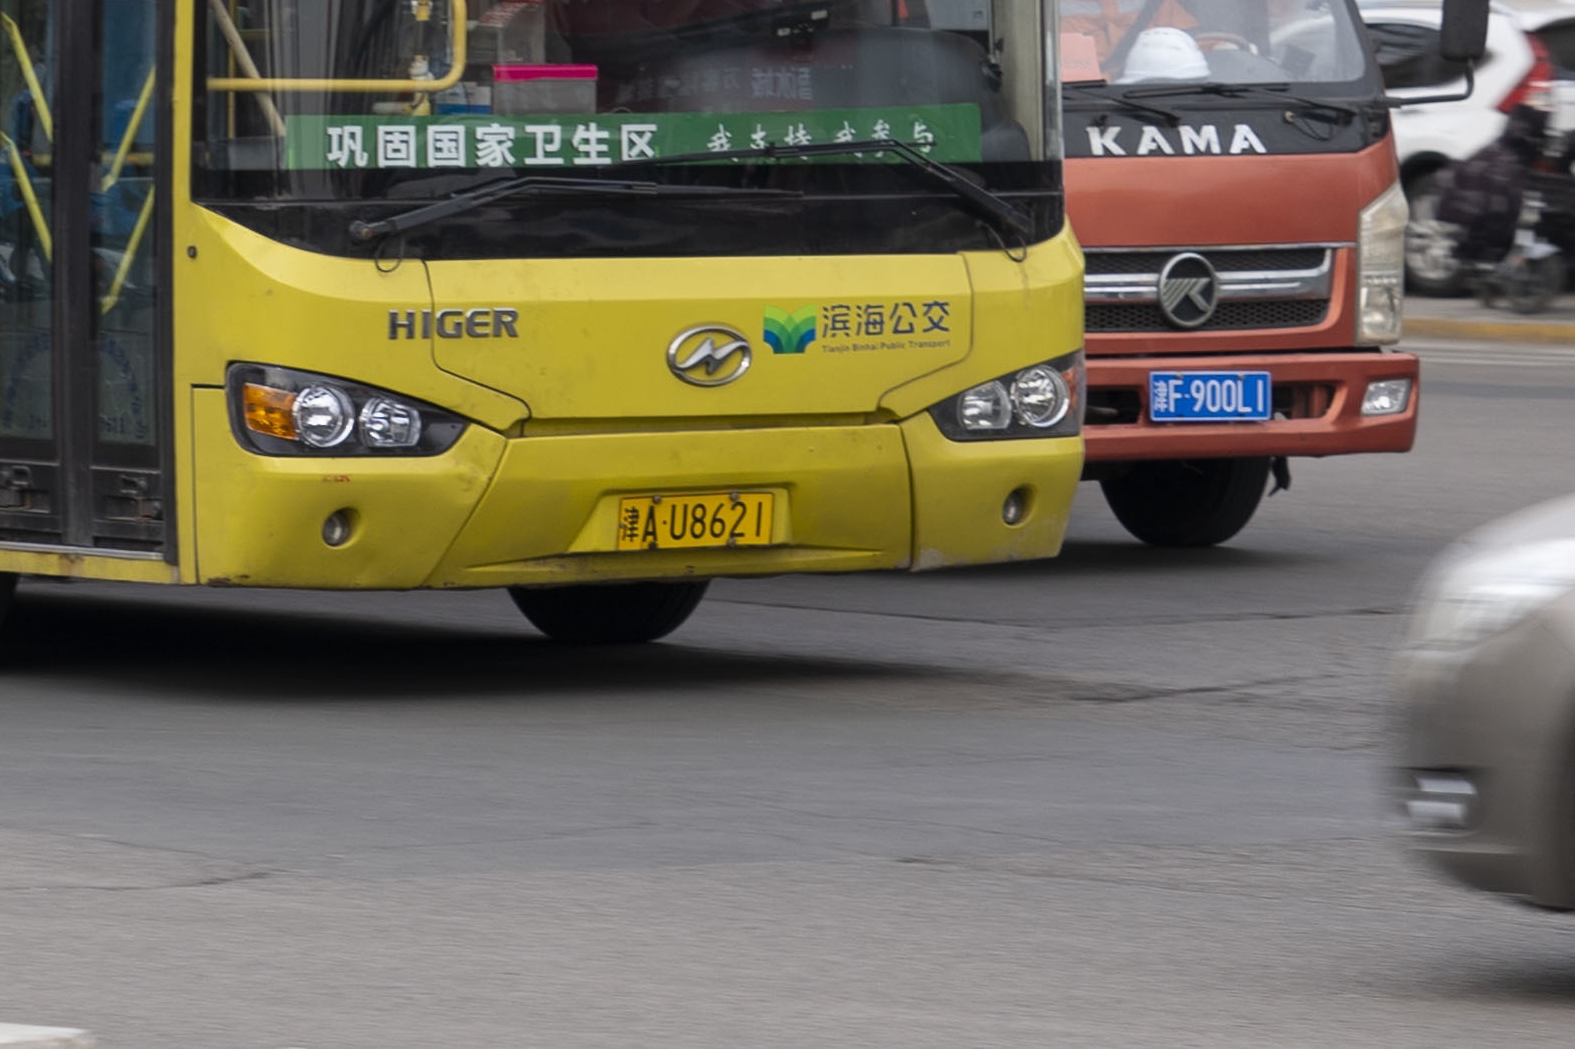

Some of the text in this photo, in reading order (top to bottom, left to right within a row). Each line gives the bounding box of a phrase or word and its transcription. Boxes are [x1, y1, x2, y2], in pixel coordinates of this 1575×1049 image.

[326, 122, 658, 168] 巩固国家卫生区
[1087, 124, 1267, 156] KAMA
[388, 307, 519, 340] HIGER
[822, 301, 950, 338] 滨海公交
[822, 344, 850, 354] Tianjin
[880, 341, 906, 350] Public
[908, 339, 951, 350] Transport
